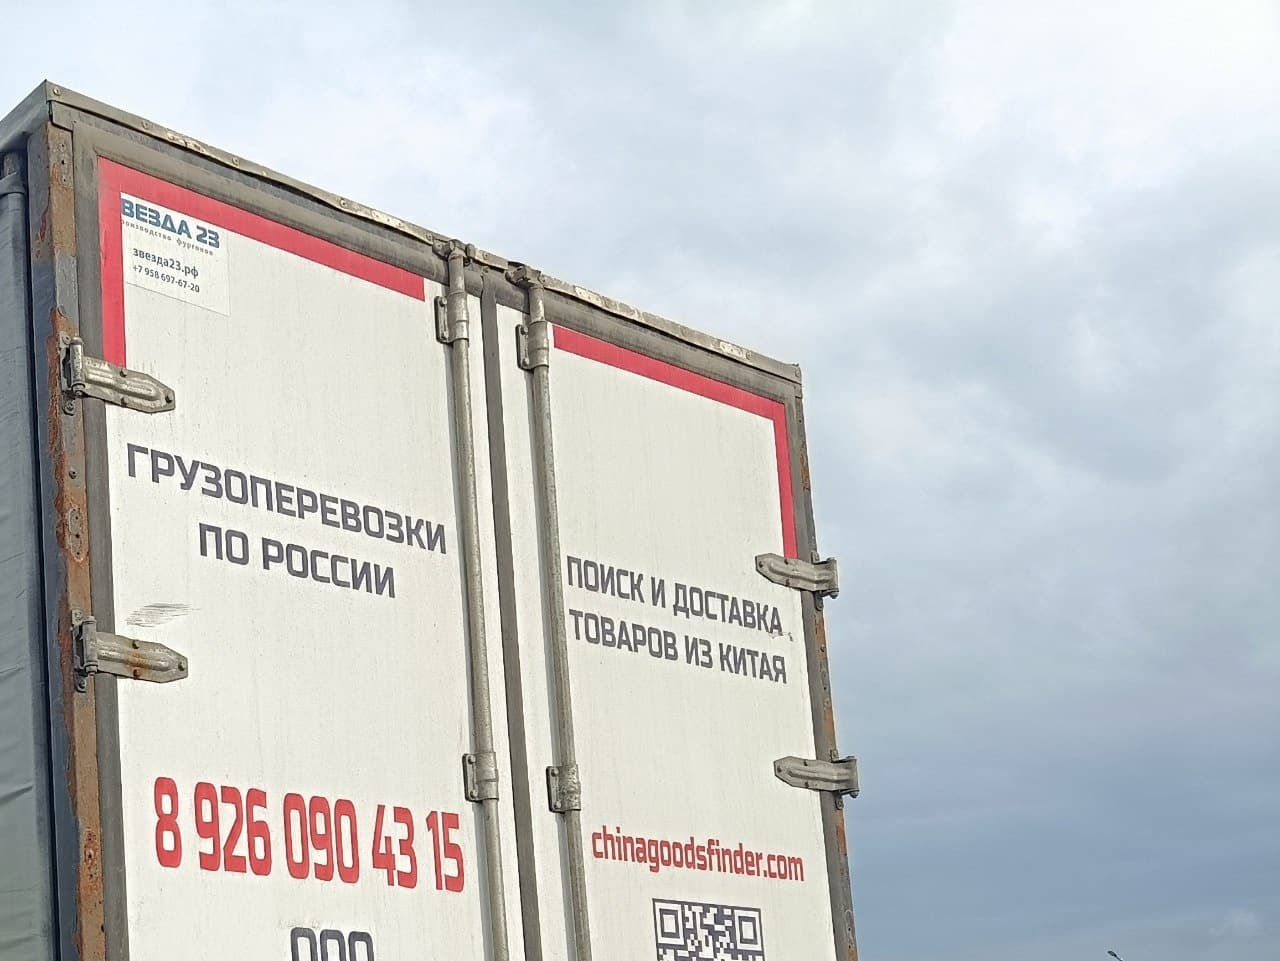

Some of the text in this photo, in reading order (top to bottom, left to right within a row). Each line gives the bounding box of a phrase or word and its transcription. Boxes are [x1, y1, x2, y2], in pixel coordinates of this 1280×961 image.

[132, 248, 199, 279] звезда23.рф
[196, 225, 220, 249] 23
[127, 442, 447, 554] ГРУЗОПЕРЕВОЗКИ
[199, 522, 396, 599] ПО РОССИИ
[567, 555, 783, 634] ПОИСК И ДОСТАВКА
[569, 608, 787, 685] ТОВАРОВ ИЗ КИТАЯ
[154, 776, 465, 893] 8 926 090 43 15
[591, 824, 805, 882] chinagoodsfinder.com
